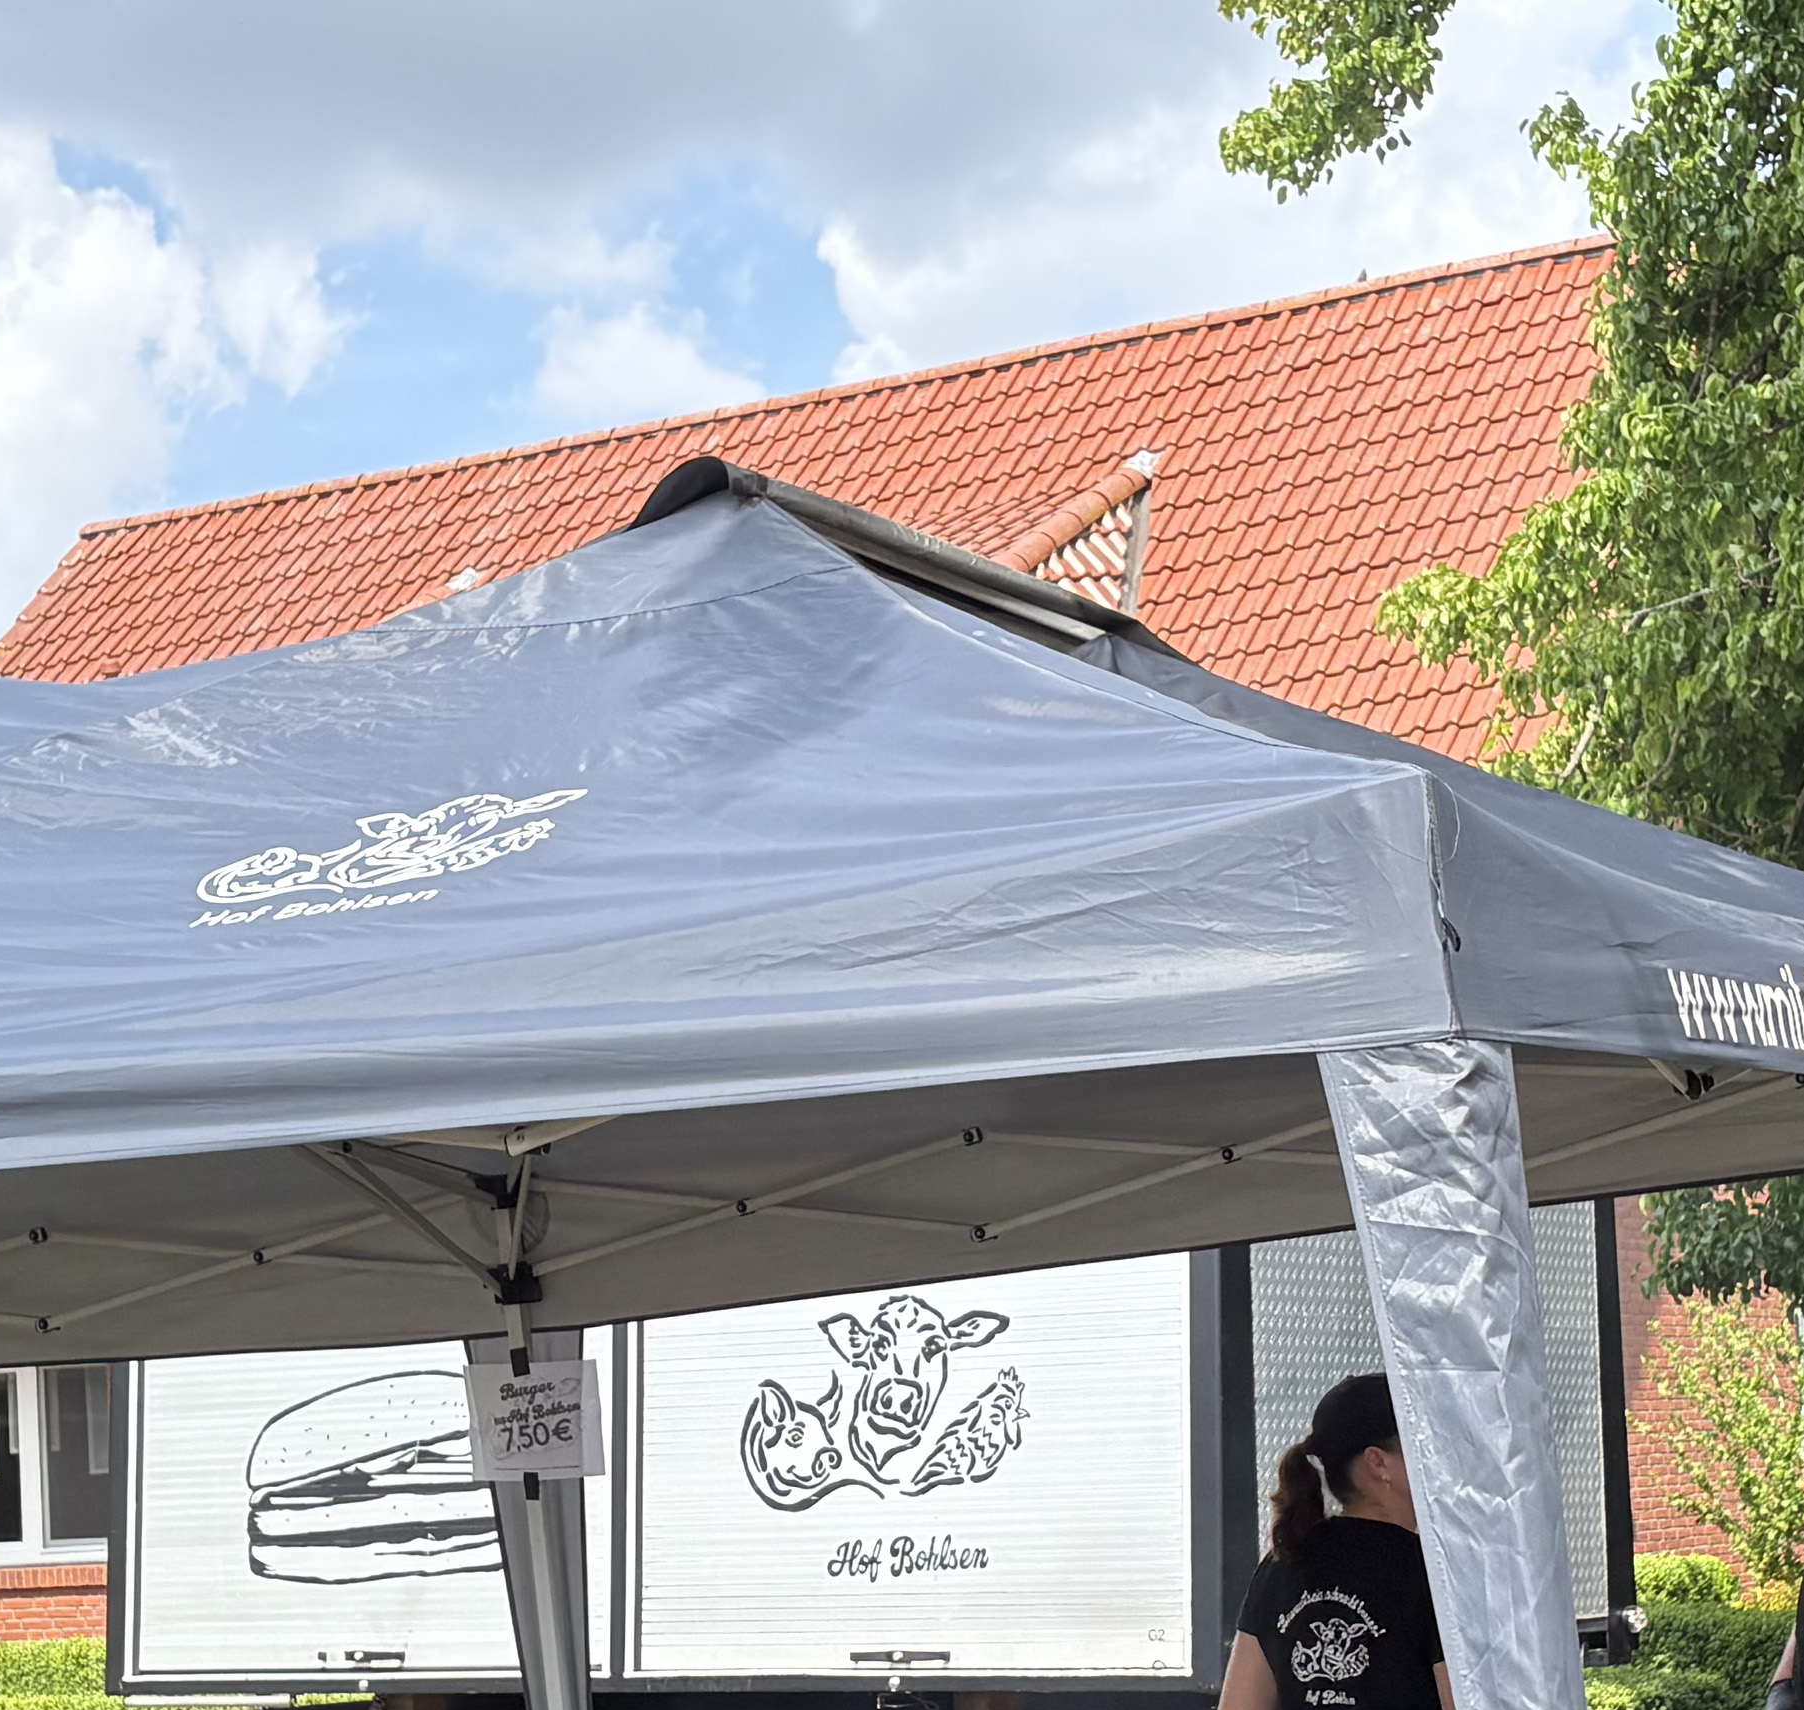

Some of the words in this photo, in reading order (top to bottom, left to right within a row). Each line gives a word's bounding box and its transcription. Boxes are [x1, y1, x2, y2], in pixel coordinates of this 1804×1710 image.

[189, 905, 273, 929] Hof
[272, 889, 439, 920] Bohlsen
[499, 1382, 556, 1405] Burger
[827, 1538, 883, 1583] Hof
[889, 1534, 989, 1578] Bohlsen
